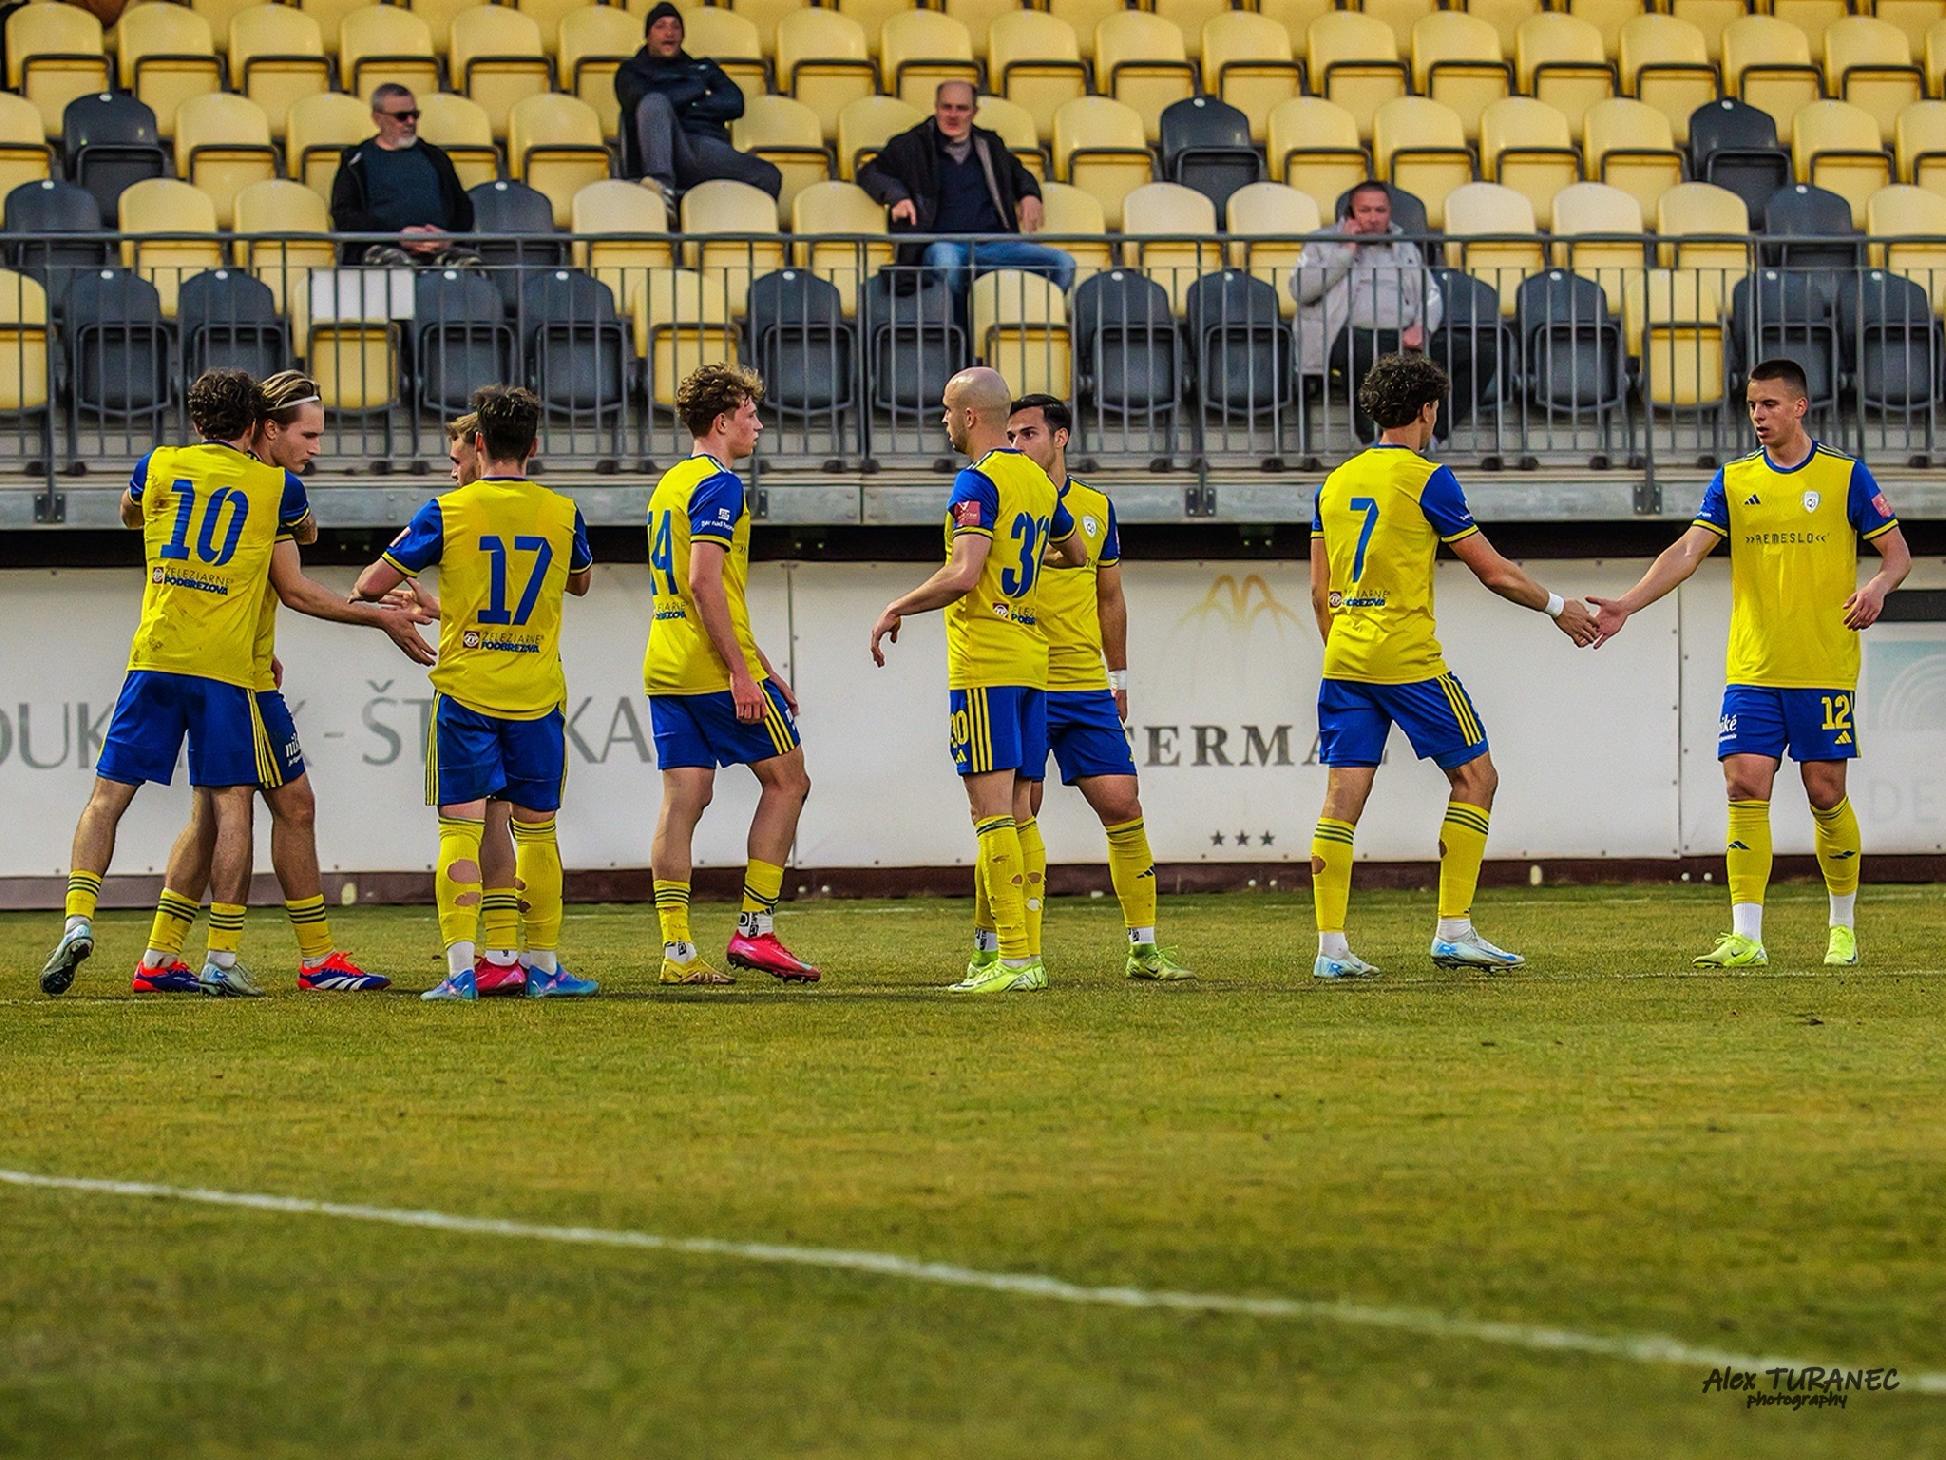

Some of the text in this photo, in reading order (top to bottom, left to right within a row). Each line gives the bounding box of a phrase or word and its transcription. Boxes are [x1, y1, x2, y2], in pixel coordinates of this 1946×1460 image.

[160, 479, 249, 567] 10
[1350, 498, 1379, 583] 7
[477, 535, 553, 625] 17
[1821, 694, 1851, 730] 12
